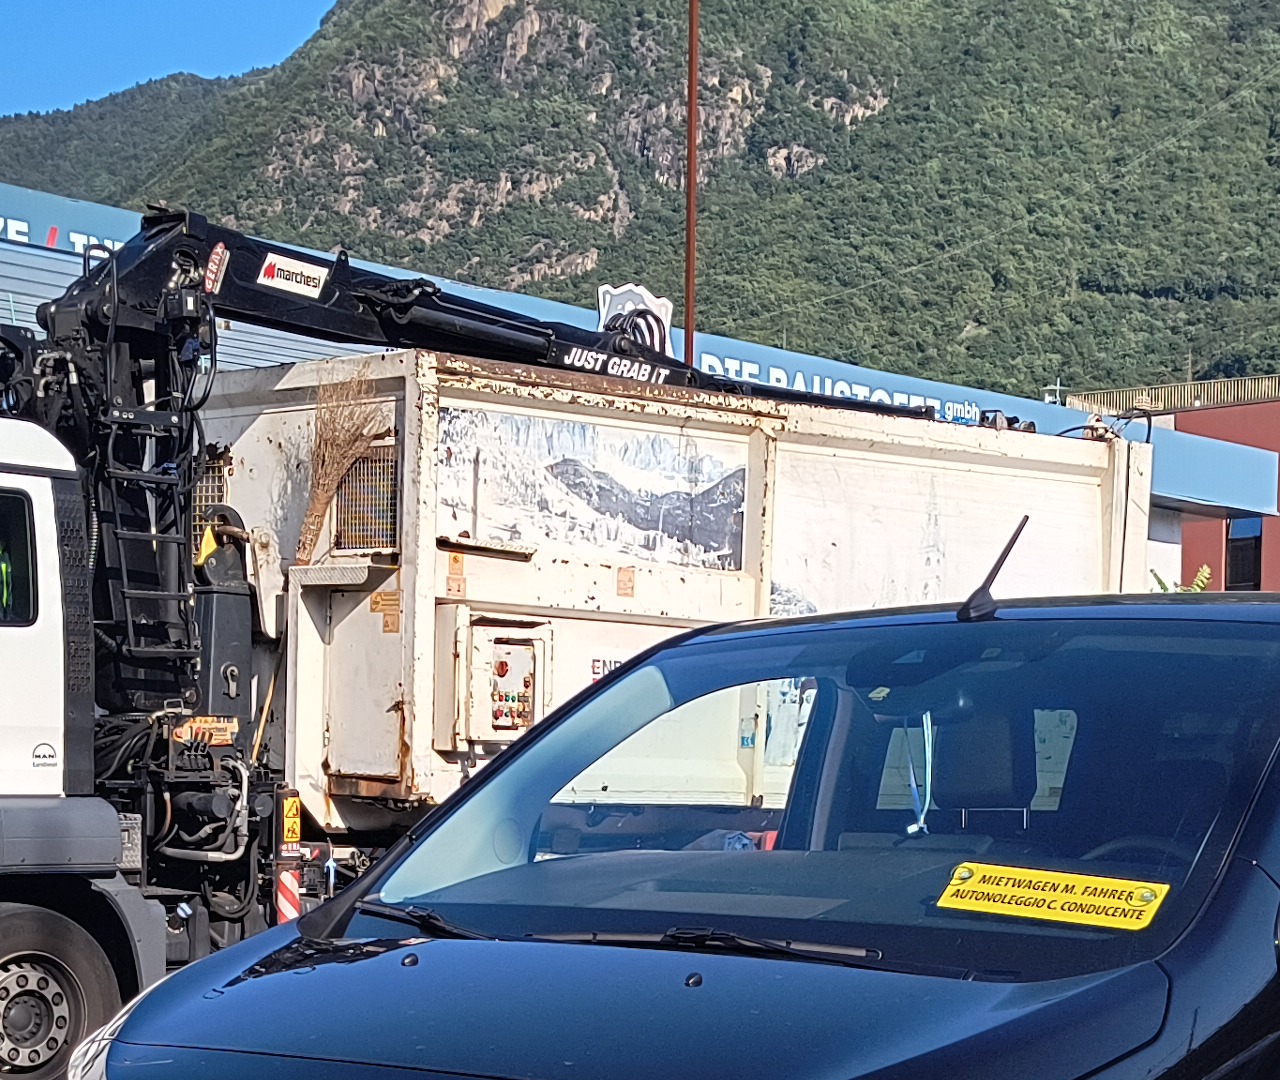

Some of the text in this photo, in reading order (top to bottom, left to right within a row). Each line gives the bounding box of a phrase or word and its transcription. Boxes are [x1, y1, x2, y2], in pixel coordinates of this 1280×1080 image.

[276, 267, 321, 290] marchesi
[564, 347, 671, 385] JUST GRAB IT
[944, 400, 980, 421] gmbh
[977, 874, 1062, 895] MIETWAGEN
[1060, 884, 1078, 896] M.
[949, 888, 1147, 921] AUTONOLEGGIO C. CONDUCENTE
